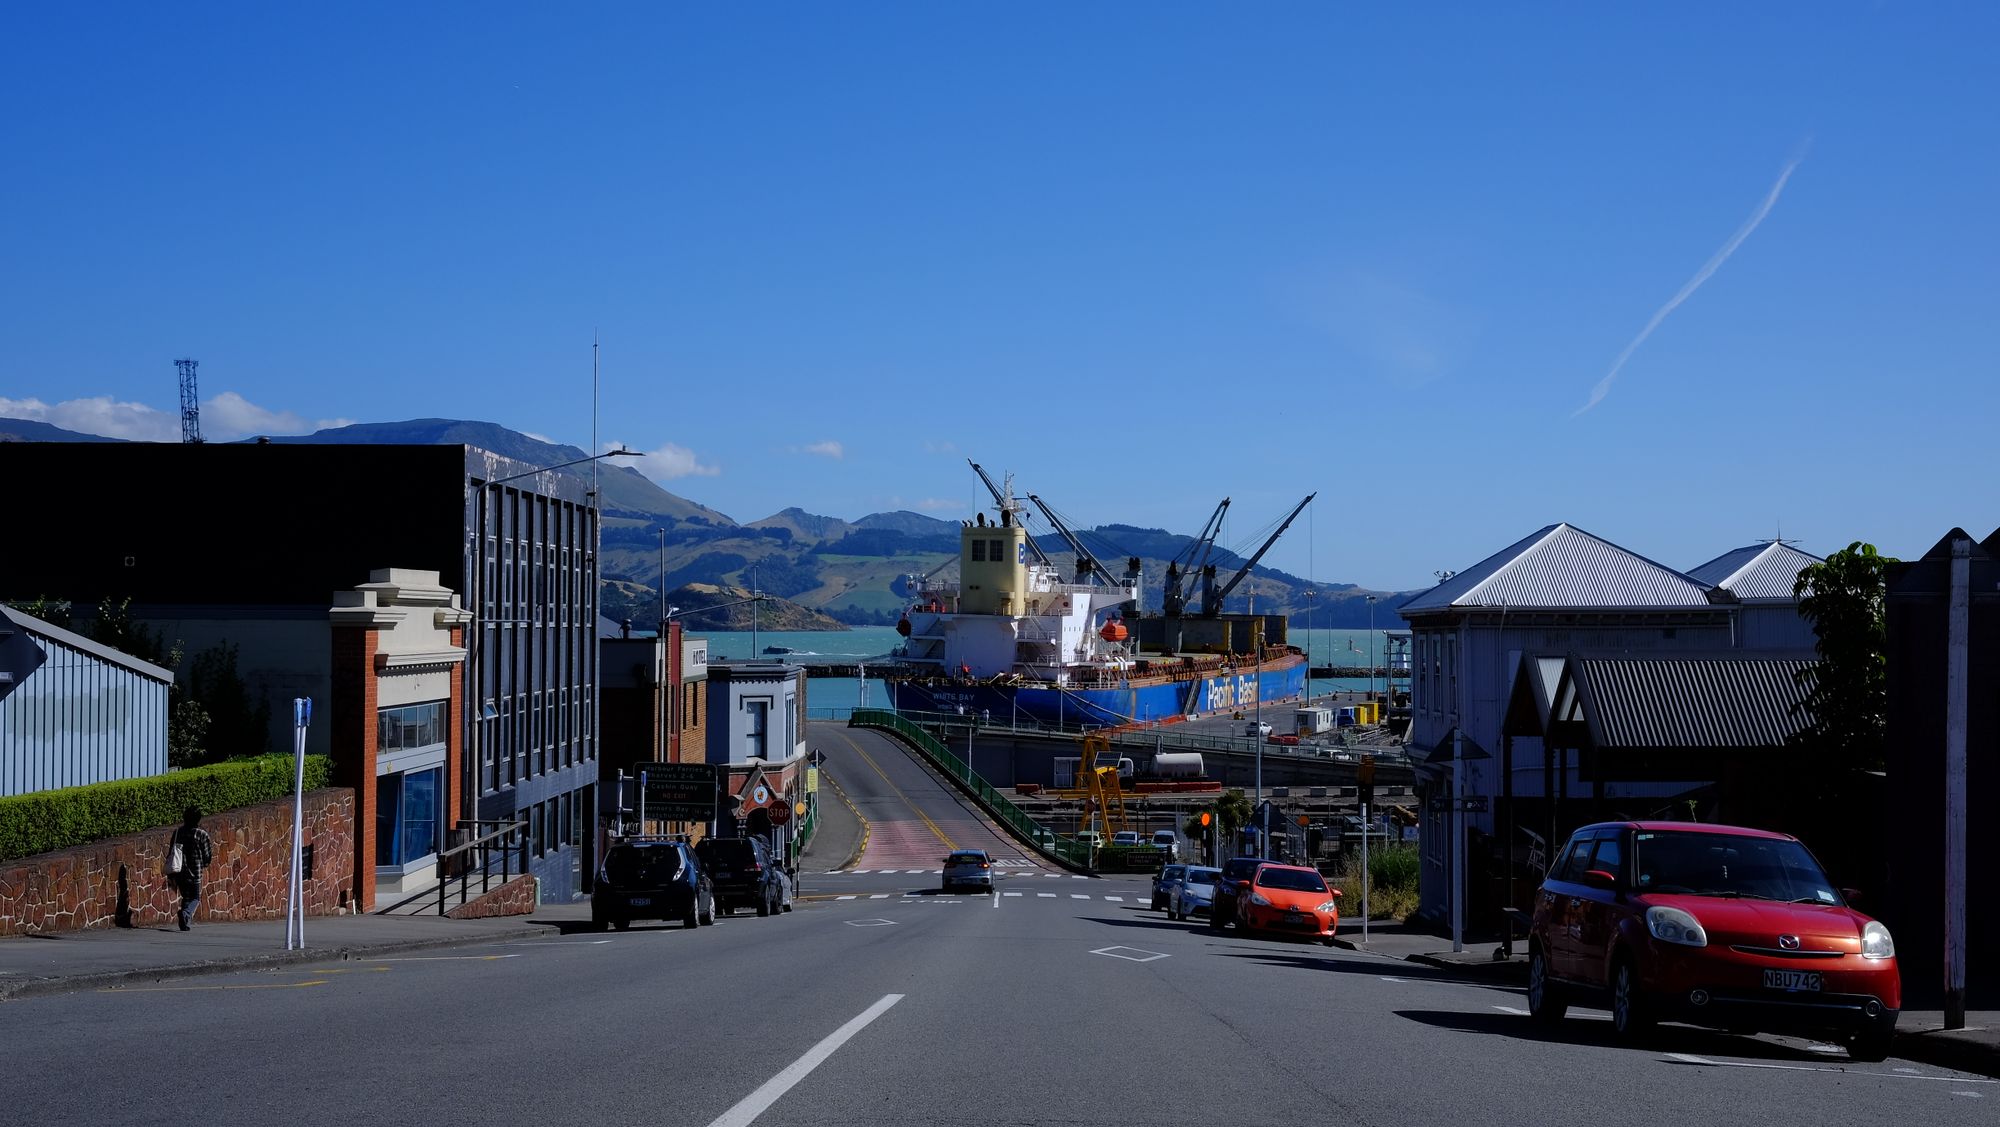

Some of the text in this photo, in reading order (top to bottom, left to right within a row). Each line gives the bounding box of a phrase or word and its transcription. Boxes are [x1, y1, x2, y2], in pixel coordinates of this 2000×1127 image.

[692, 649, 706, 665] HOTEL
[958, 693, 975, 702] BAY
[1208, 676, 1234, 711] Pacific
[769, 808, 790, 818] STOP
[1765, 972, 1820, 990] NBU742
